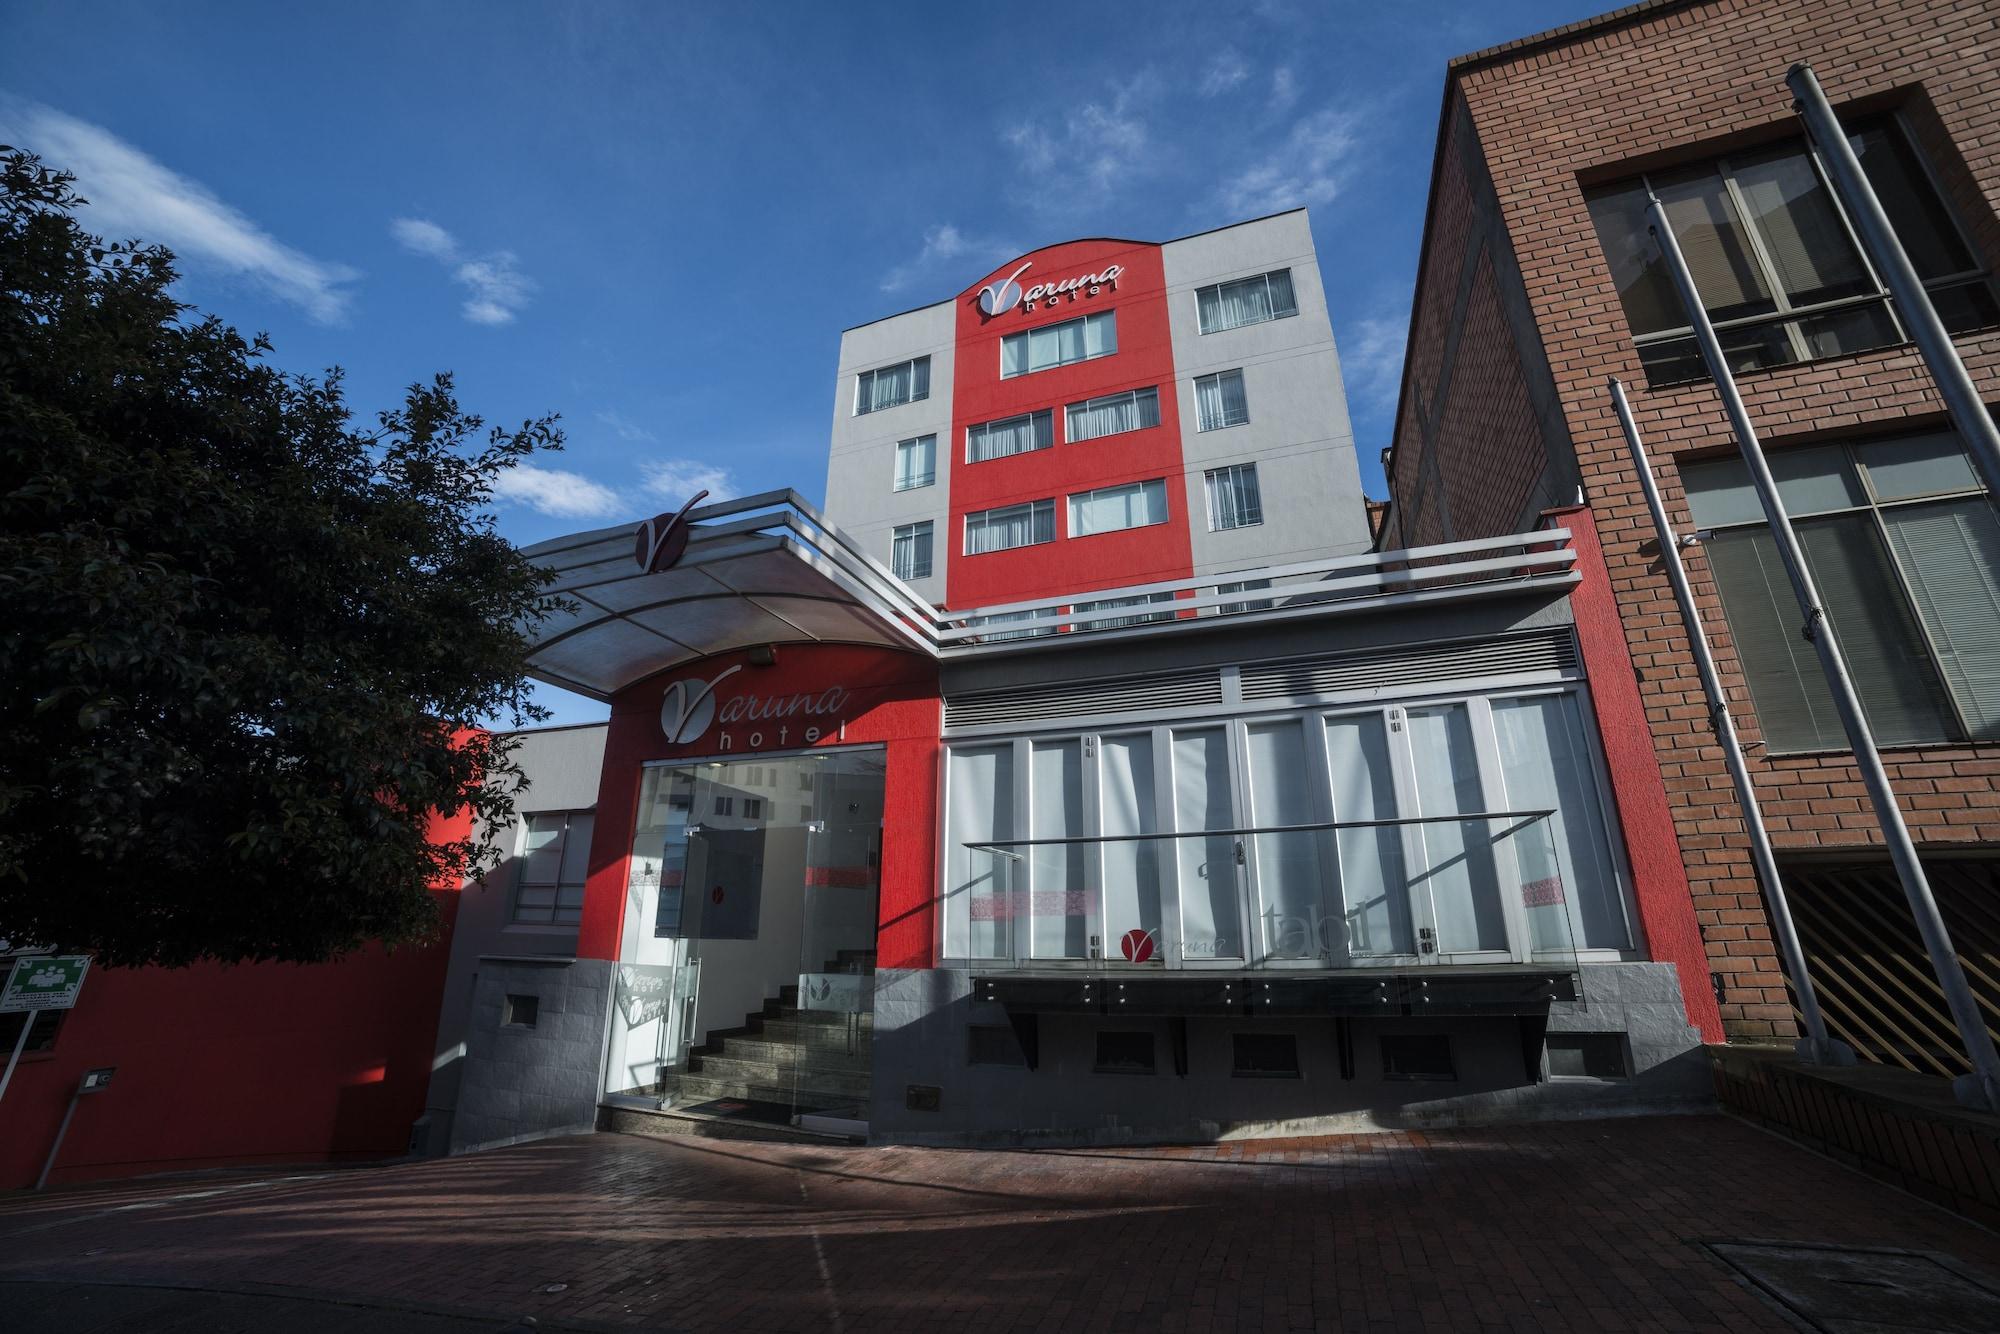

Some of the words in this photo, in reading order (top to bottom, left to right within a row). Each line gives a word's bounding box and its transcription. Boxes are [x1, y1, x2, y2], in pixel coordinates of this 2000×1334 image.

[977, 261, 1125, 316] Varuna
[1026, 279, 1118, 312] hotel
[662, 664, 850, 744] Varuna
[720, 719, 846, 750] hotel
